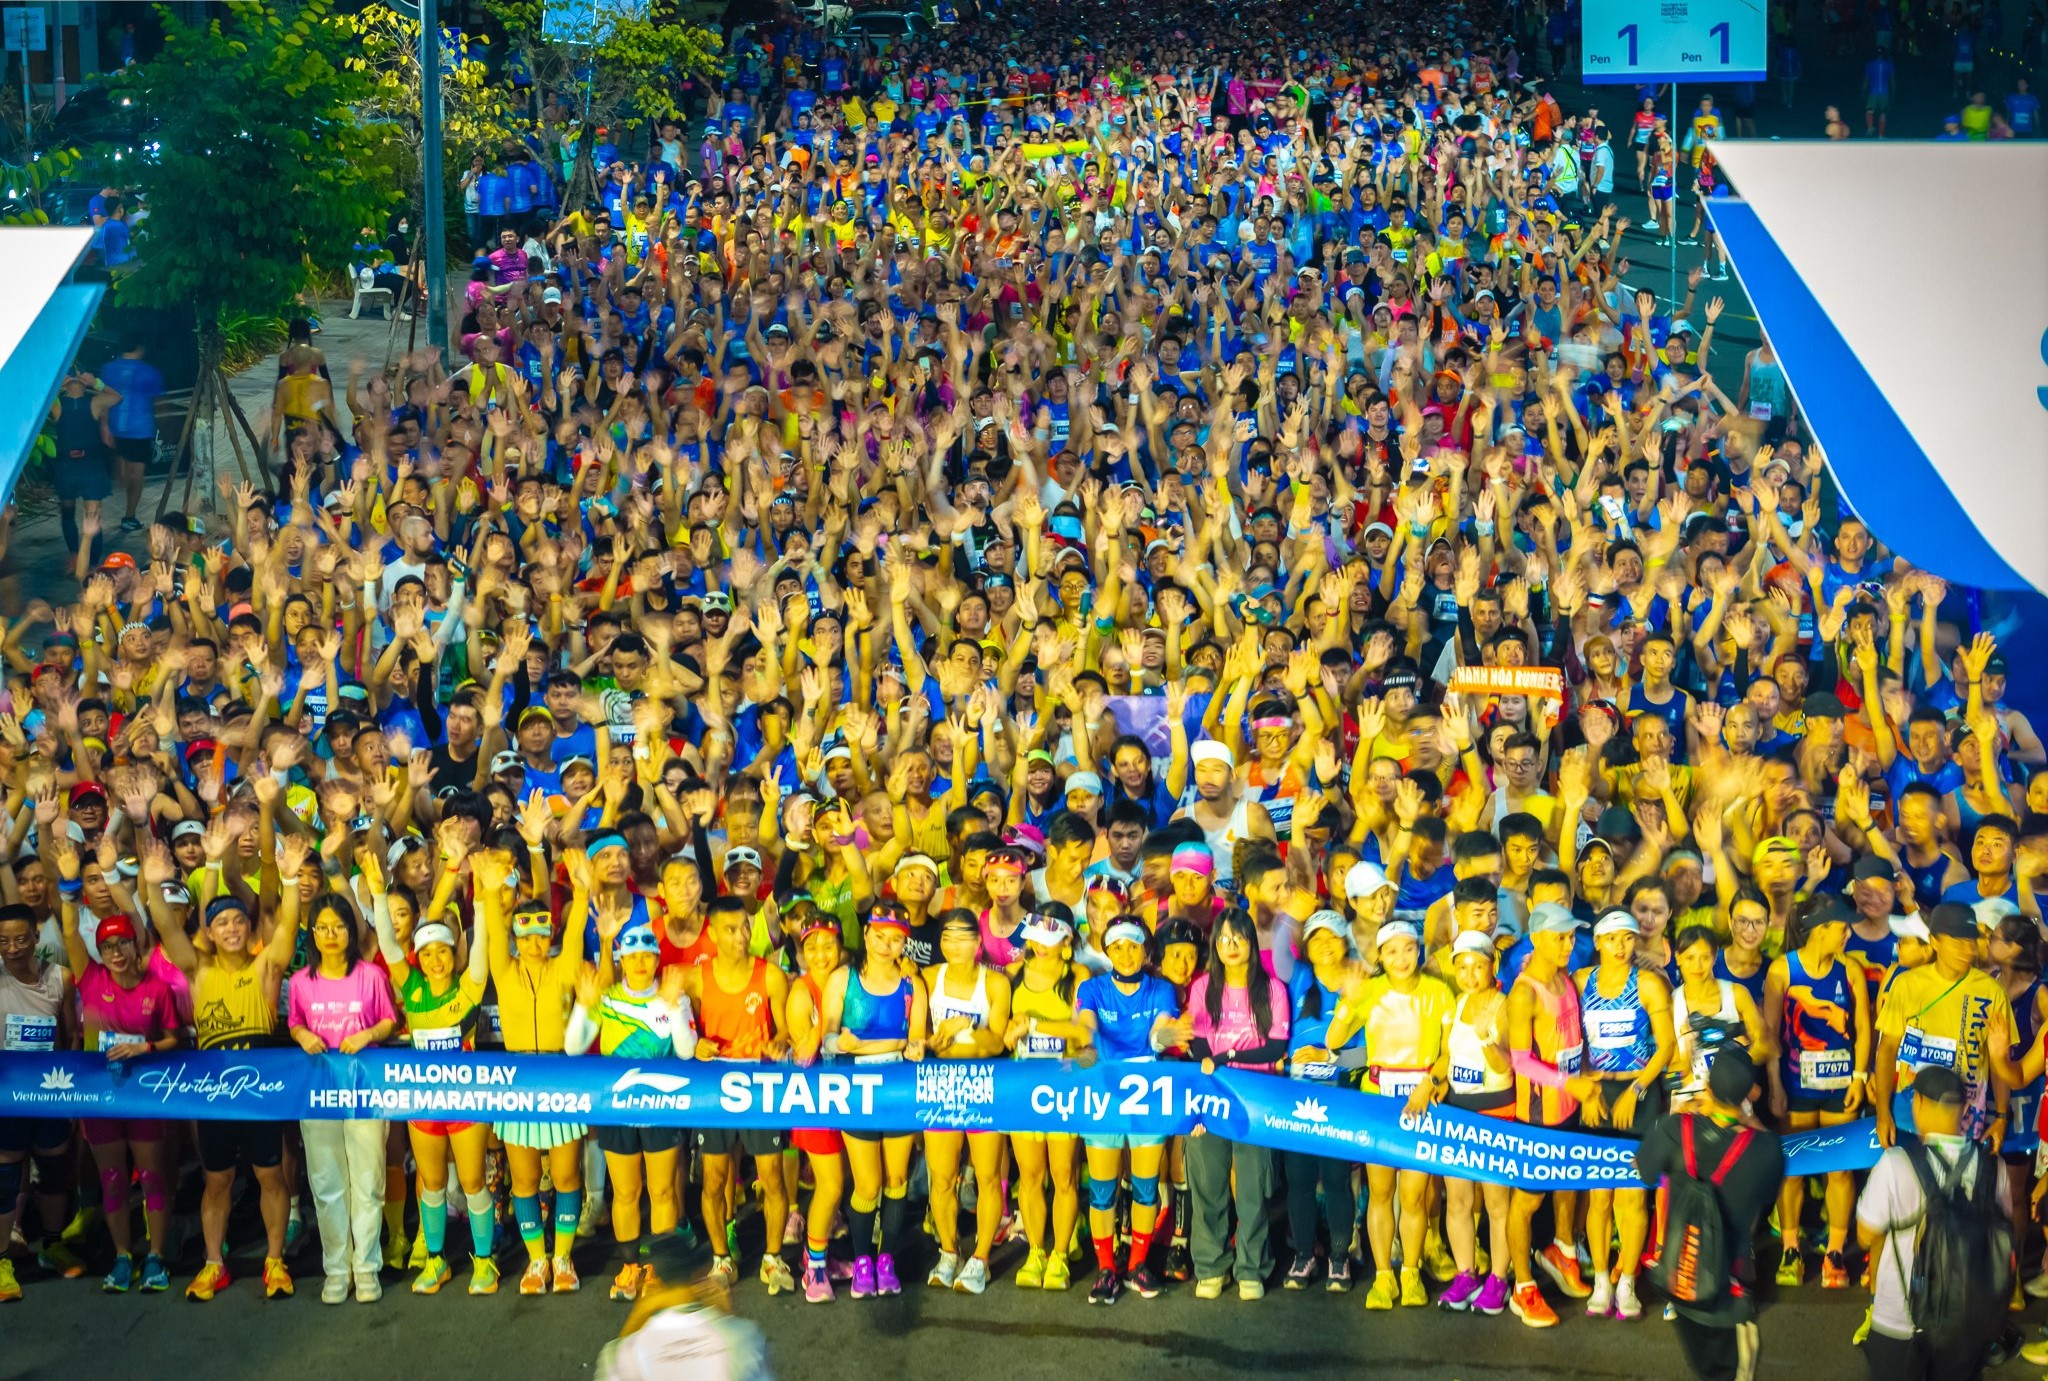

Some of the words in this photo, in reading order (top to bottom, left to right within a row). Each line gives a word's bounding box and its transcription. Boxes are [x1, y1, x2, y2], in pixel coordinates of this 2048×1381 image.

[1590, 54, 1611, 64] Pen
[1617, 24, 1638, 66] 1
[1681, 52, 1702, 62] Pen
[1709, 22, 1730, 64] 1
[1453, 666, 1488, 687] HANH
[1515, 669, 1563, 692] RUNNER
[23, 1027, 52, 1037] 22101
[1903, 1043, 1918, 1057] VIP
[384, 1063, 473, 1085] HALONG
[476, 1065, 517, 1086] BAY
[916, 1064, 967, 1077] HALONG
[12, 1090, 57, 1102] Vietnam
[57, 1090, 99, 1102] Airlines
[310, 1089, 412, 1109] HERITAGE
[413, 1090, 534, 1112] MARATHON
[536, 1092, 592, 1114] 2024
[611, 1092, 692, 1110] LI-NING
[720, 1072, 884, 1116] START
[916, 1090, 994, 1104] MARATHON
[1031, 1085, 1079, 1122] Cự
[1084, 1085, 1111, 1121] ly
[1119, 1074, 1173, 1116] 21
[1184, 1088, 1231, 1119] km
[1264, 1113, 1311, 1134] Vietnam
[1310, 1122, 1353, 1142] Airlines
[1445, 1120, 1566, 1160] MARATHON
[1569, 1145, 1636, 1162] QUỐC
[1415, 1141, 1438, 1162] DI
[1489, 1154, 1519, 1179] HẠ
[1523, 1162, 1583, 1180] LONG
[1586, 1165, 1641, 1180] 2024
